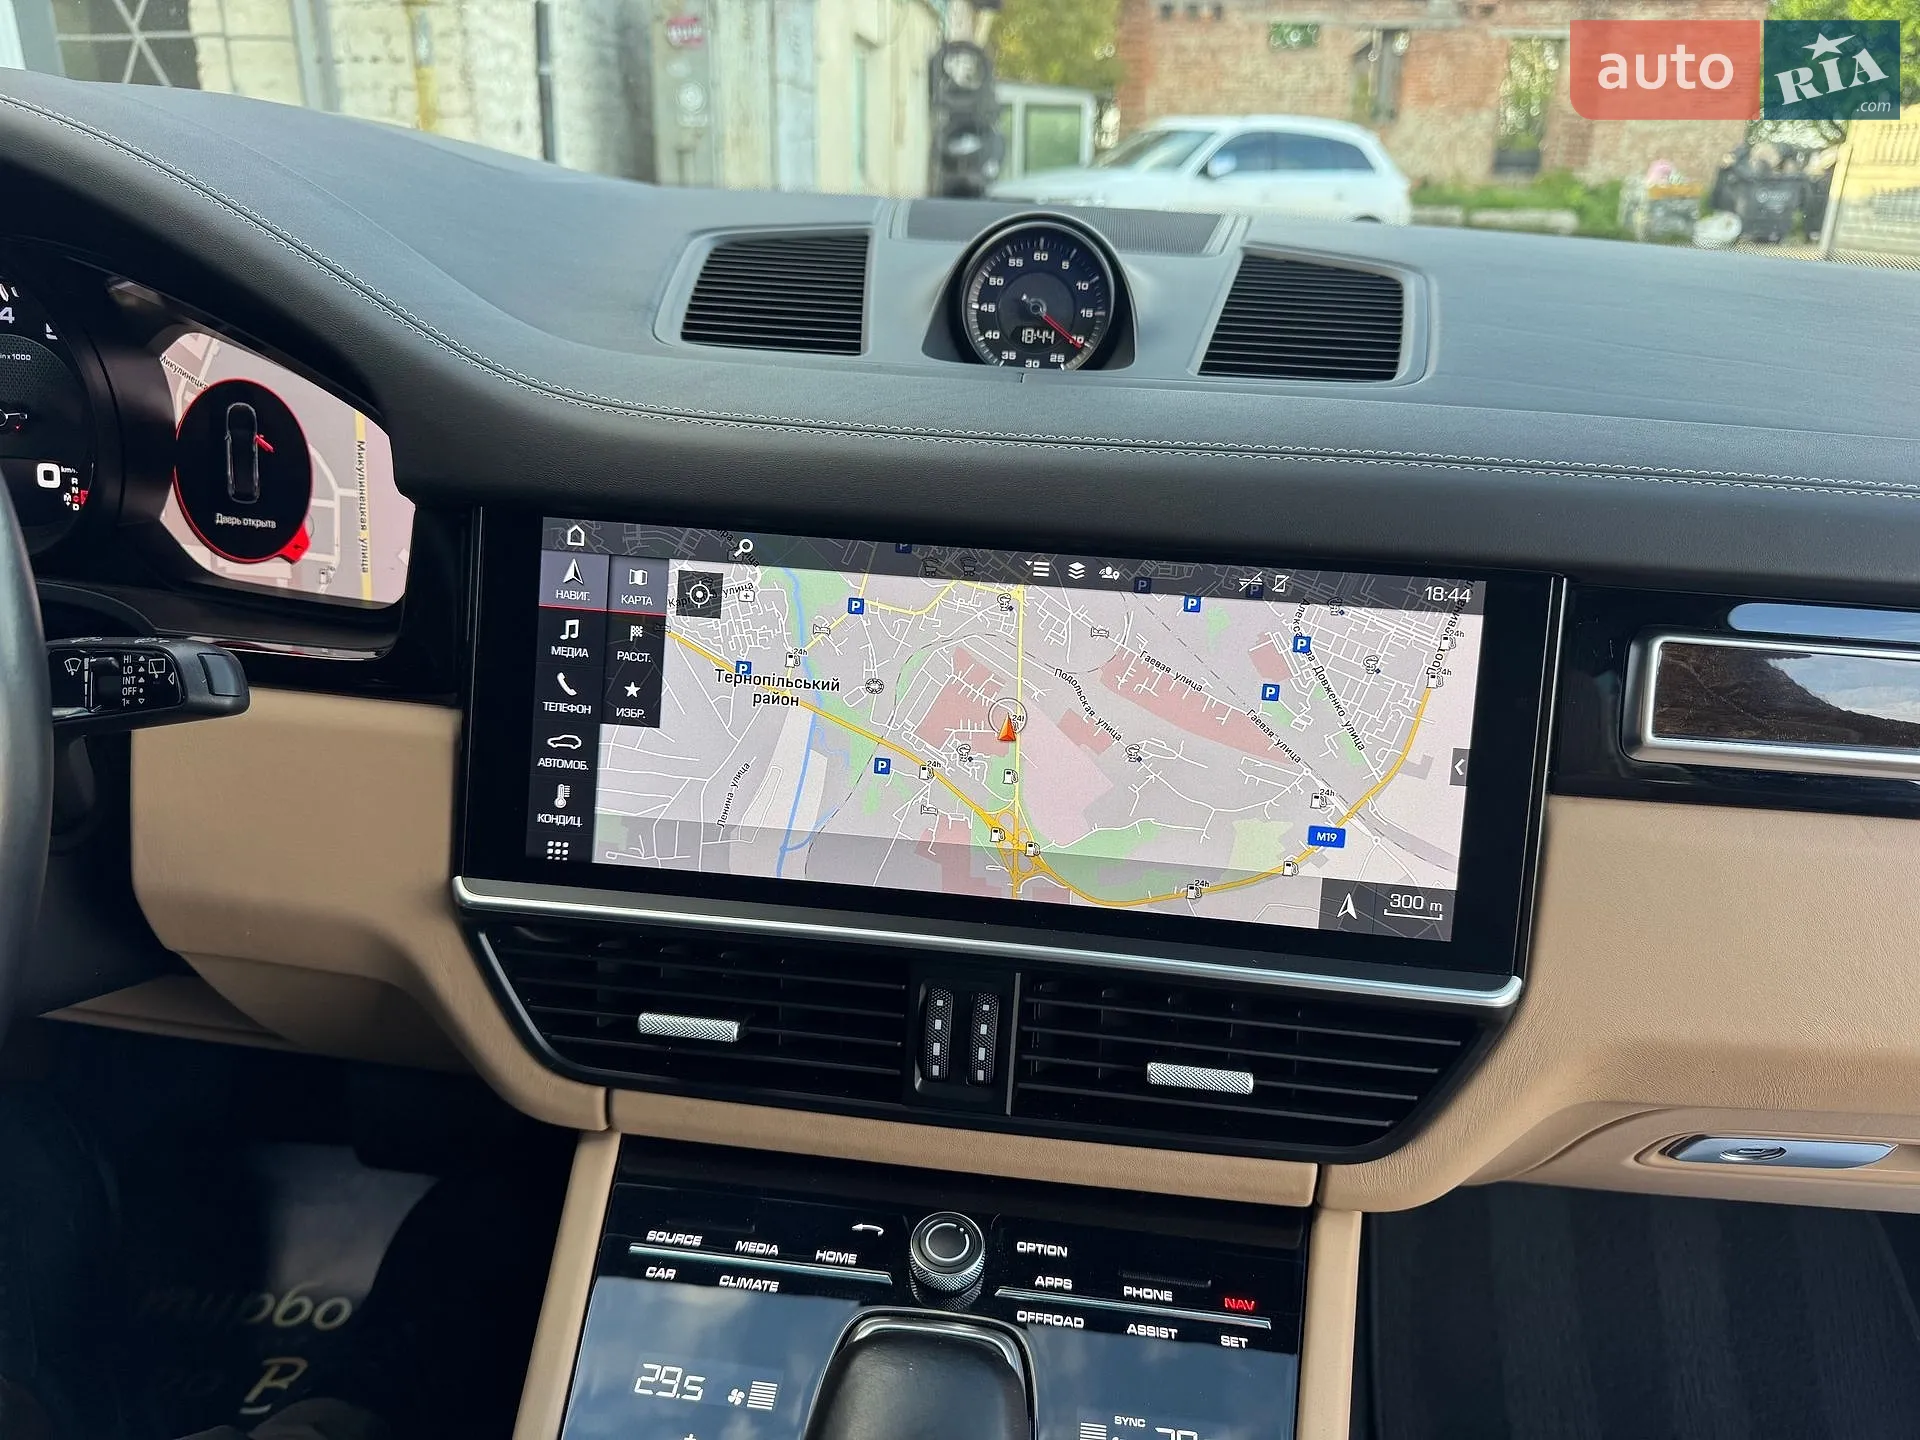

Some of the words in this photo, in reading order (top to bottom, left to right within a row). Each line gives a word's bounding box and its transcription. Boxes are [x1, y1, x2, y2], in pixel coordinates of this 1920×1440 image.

[1008, 259, 1023, 267] 55
[1033, 253, 1048, 261] 60
[1061, 261, 1069, 270] 5
[989, 278, 1004, 286] 50
[1076, 282, 1089, 291] 10
[980, 304, 996, 313] 45
[1080, 309, 1093, 318] 15
[985, 331, 1000, 339] 40
[1022, 328, 1055, 344] 18:44
[12, 353, 31, 361] 1000
[1001, 351, 1017, 360] 35
[1050, 354, 1065, 363] 25
[1025, 360, 1040, 368] 30
[36, 462, 61, 489] 0
[357, 440, 368, 531] Микулинецкая
[358, 536, 369, 573] улица
[555, 590, 591, 601] НАВИГ.
[621, 595, 653, 606] КАРТА
[1425, 586, 1471, 603] 18:44
[1448, 629, 1465, 638] 24h
[551, 646, 589, 658] МЕДИА
[617, 652, 651, 663] РАССТ.
[793, 648, 808, 656] 24h
[123, 655, 132, 664] HI
[123, 665, 133, 675] LO
[1139, 650, 1172, 674] Гаевая
[1173, 671, 1203, 692] улица
[1436, 668, 1452, 677] 24h
[122, 676, 136, 685] INT
[714, 668, 841, 692] Тернопільський
[122, 687, 137, 696] OFF
[752, 692, 800, 707] район
[1053, 668, 1096, 717] Подольская
[1095, 717, 1122, 743] улица
[542, 701, 592, 715] ТЕЛЕФОН
[616, 708, 646, 719] ИЗБР.
[1312, 665, 1346, 718] Довженко
[1343, 720, 1366, 752] улица
[1246, 709, 1275, 738] Гаевая
[1274, 738, 1302, 764] улица
[537, 758, 589, 771] АВТОМОБ.
[927, 759, 942, 768] 24h
[717, 792, 735, 828] Ленина
[731, 762, 750, 789] улица
[1319, 788, 1335, 797] 24h
[537, 813, 583, 827] КОНДИЦ.
[1317, 831, 1338, 844] M19
[1194, 879, 1210, 888] 24h
[1389, 893, 1424, 911] 300
[1430, 902, 1443, 912] m
[646, 1230, 703, 1247] SOURCE
[735, 1240, 779, 1256] MEDIA
[1017, 1241, 1068, 1257] OPTION
[816, 1250, 857, 1265] HOME
[645, 1266, 676, 1281] CAR
[719, 1275, 780, 1293] CLIMATE
[1035, 1276, 1073, 1290] APPS
[1123, 1286, 1173, 1302] PHONE
[1225, 1298, 1255, 1311] NAV
[1016, 1310, 1084, 1329] OFFROAD
[1127, 1323, 1178, 1340] ASSIST
[1220, 1335, 1248, 1349] SET
[634, 1363, 706, 1402] 29.5
[1114, 1415, 1146, 1428] SYNC
